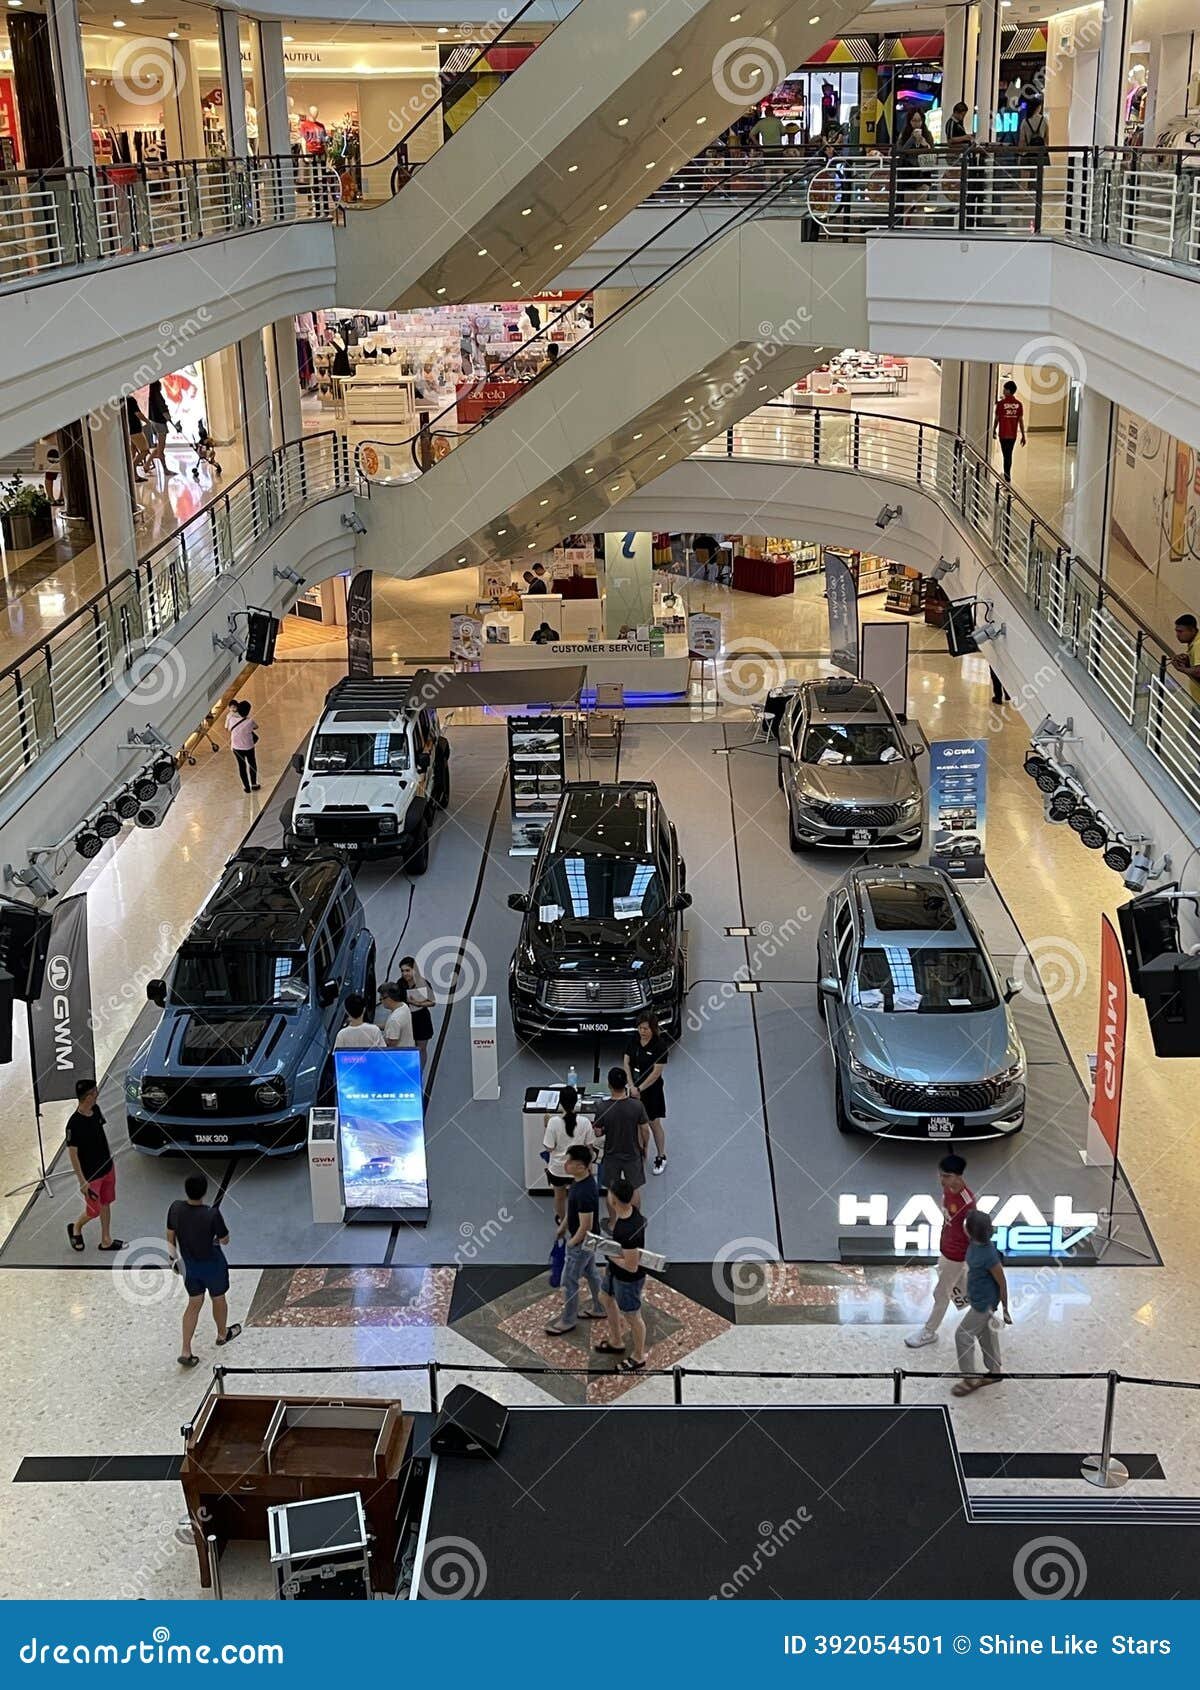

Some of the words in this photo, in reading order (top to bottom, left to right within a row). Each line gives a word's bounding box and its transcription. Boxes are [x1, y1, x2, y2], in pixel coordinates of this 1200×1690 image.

[551, 644, 605, 653] CUSTOMER
[608, 643, 650, 652] SERVICE
[580, 1023, 595, 1031] TANK
[595, 1023, 609, 1032] 500
[53, 994, 75, 1071] GWM
[195, 1134, 213, 1143] TANK
[213, 1134, 229, 1143] 300
